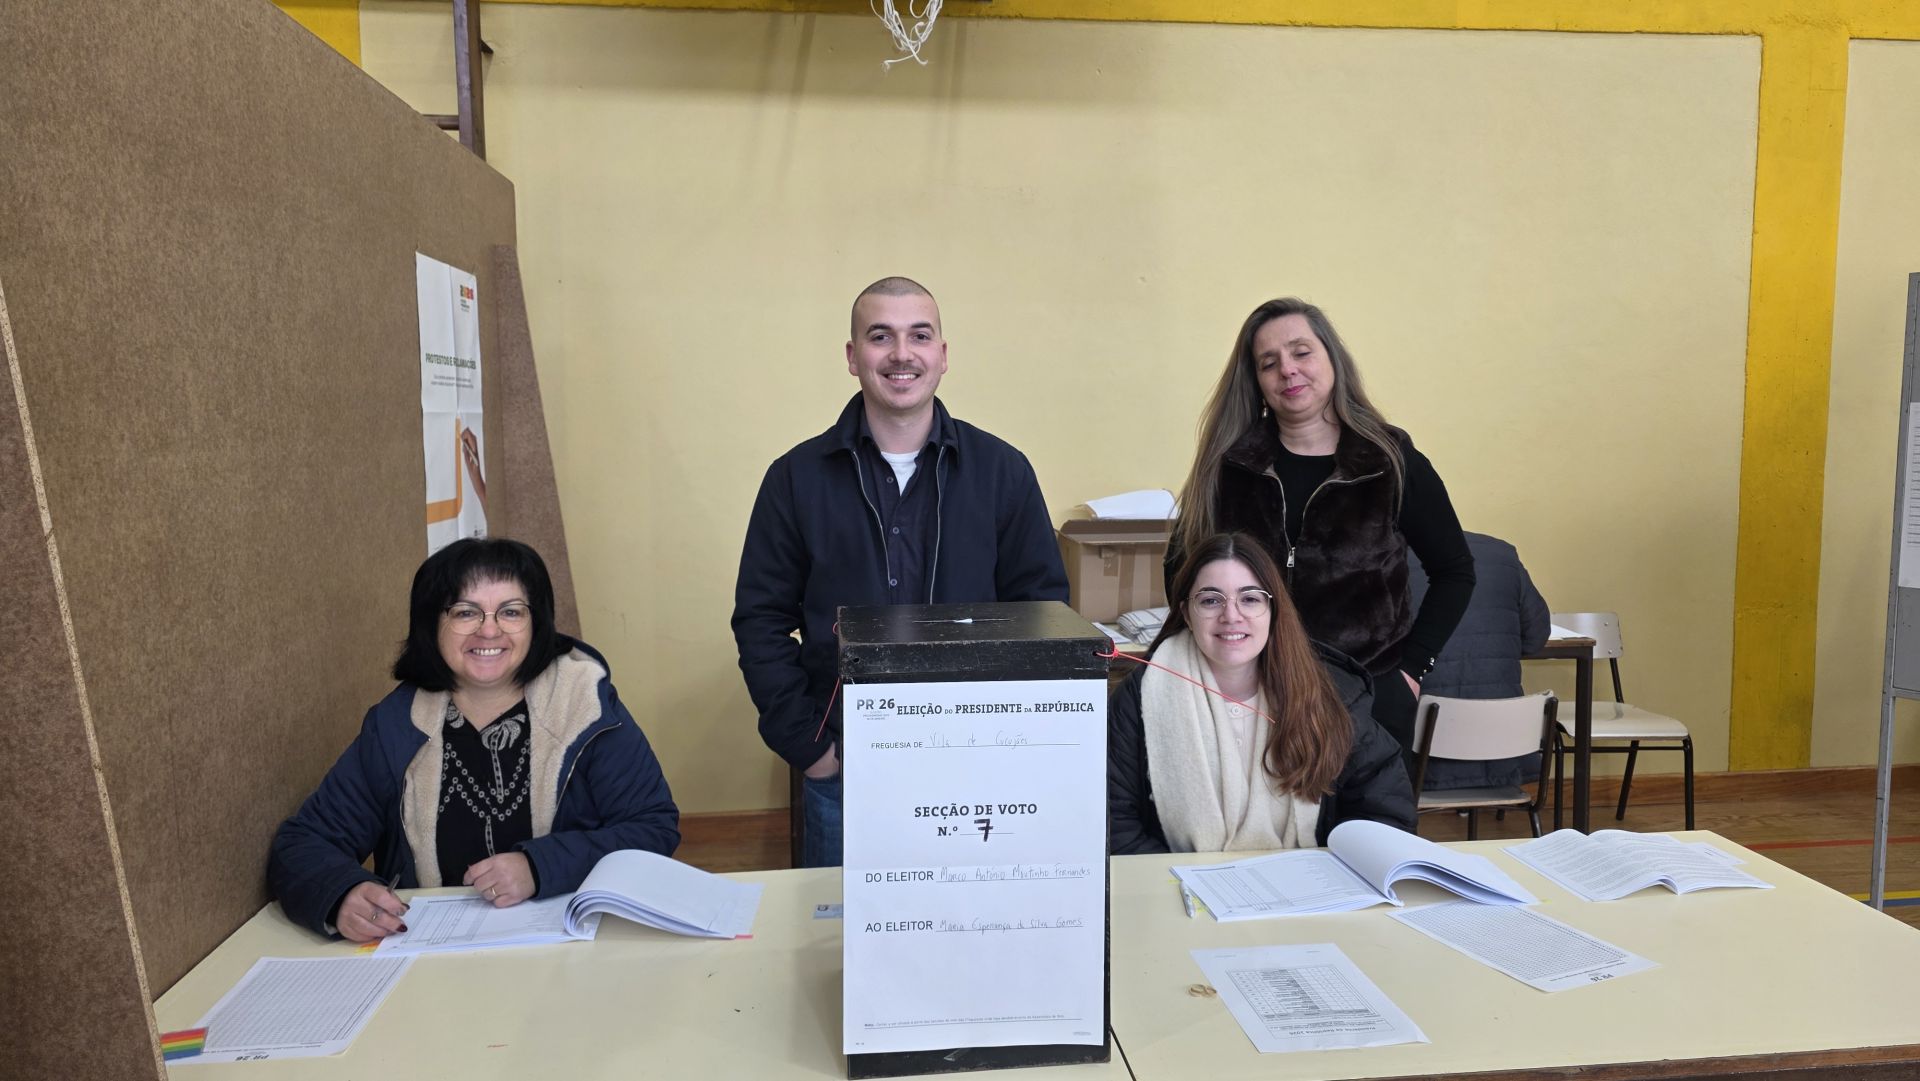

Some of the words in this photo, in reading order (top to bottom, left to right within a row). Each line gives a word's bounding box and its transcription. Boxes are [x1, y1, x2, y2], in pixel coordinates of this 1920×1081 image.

[856, 699, 875, 710] PR
[879, 698, 896, 710] 26
[897, 703, 942, 717] ELEIÇÃO
[955, 703, 1022, 714] PRESIDENTE
[1034, 700, 1095, 713] REPÚBLICA
[914, 802, 970, 820] SECÇÃO
[974, 804, 993, 816] DE
[997, 803, 1038, 815] VOTO
[937, 825, 958, 837] N.º
[973, 818, 994, 842] 7
[865, 872, 882, 883] DO
[886, 870, 934, 882] ELEITOR
[865, 922, 882, 933] AO
[885, 920, 933, 932] ELEITOR
